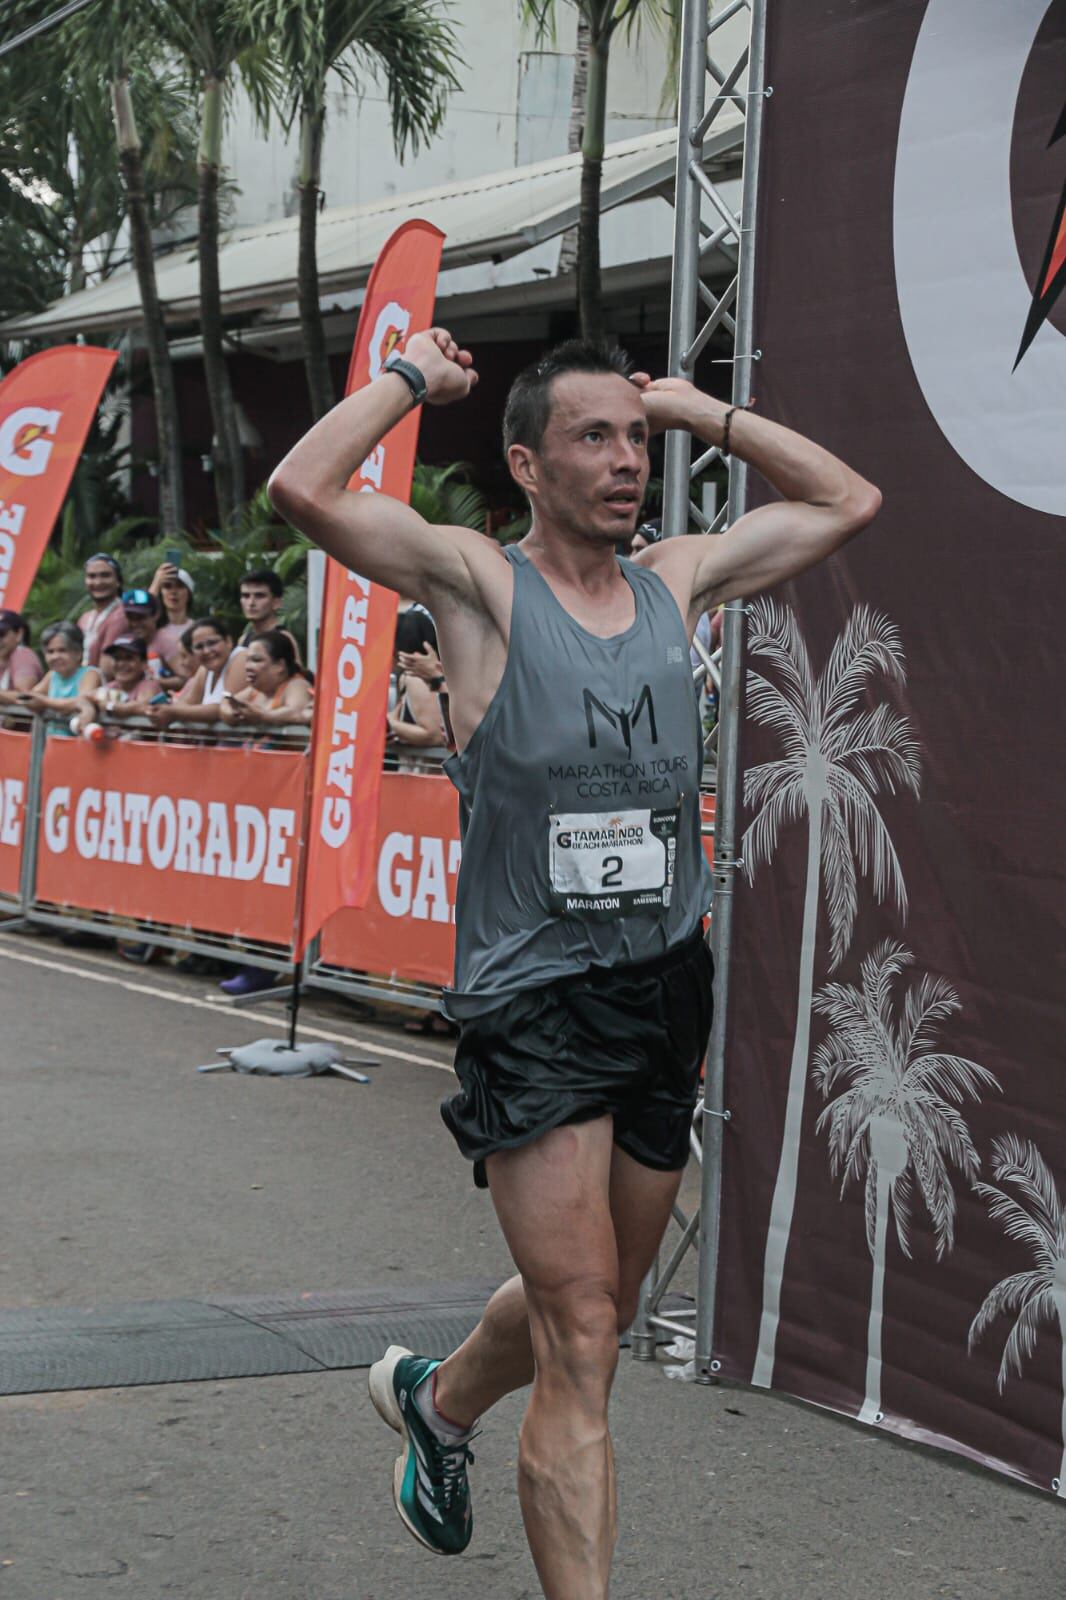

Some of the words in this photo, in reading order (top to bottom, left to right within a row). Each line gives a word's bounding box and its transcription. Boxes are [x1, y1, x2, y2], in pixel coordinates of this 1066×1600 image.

[0, 407, 63, 477] G
[548, 762, 645, 781] MARATHON
[650, 755, 688, 775] TOURS
[577, 781, 631, 798] COSTA
[639, 778, 671, 794] RICA
[75, 788, 295, 887] GATORADE
[572, 841, 600, 850] BEACH
[602, 838, 643, 849] MARATHON
[602, 856, 623, 888] 2
